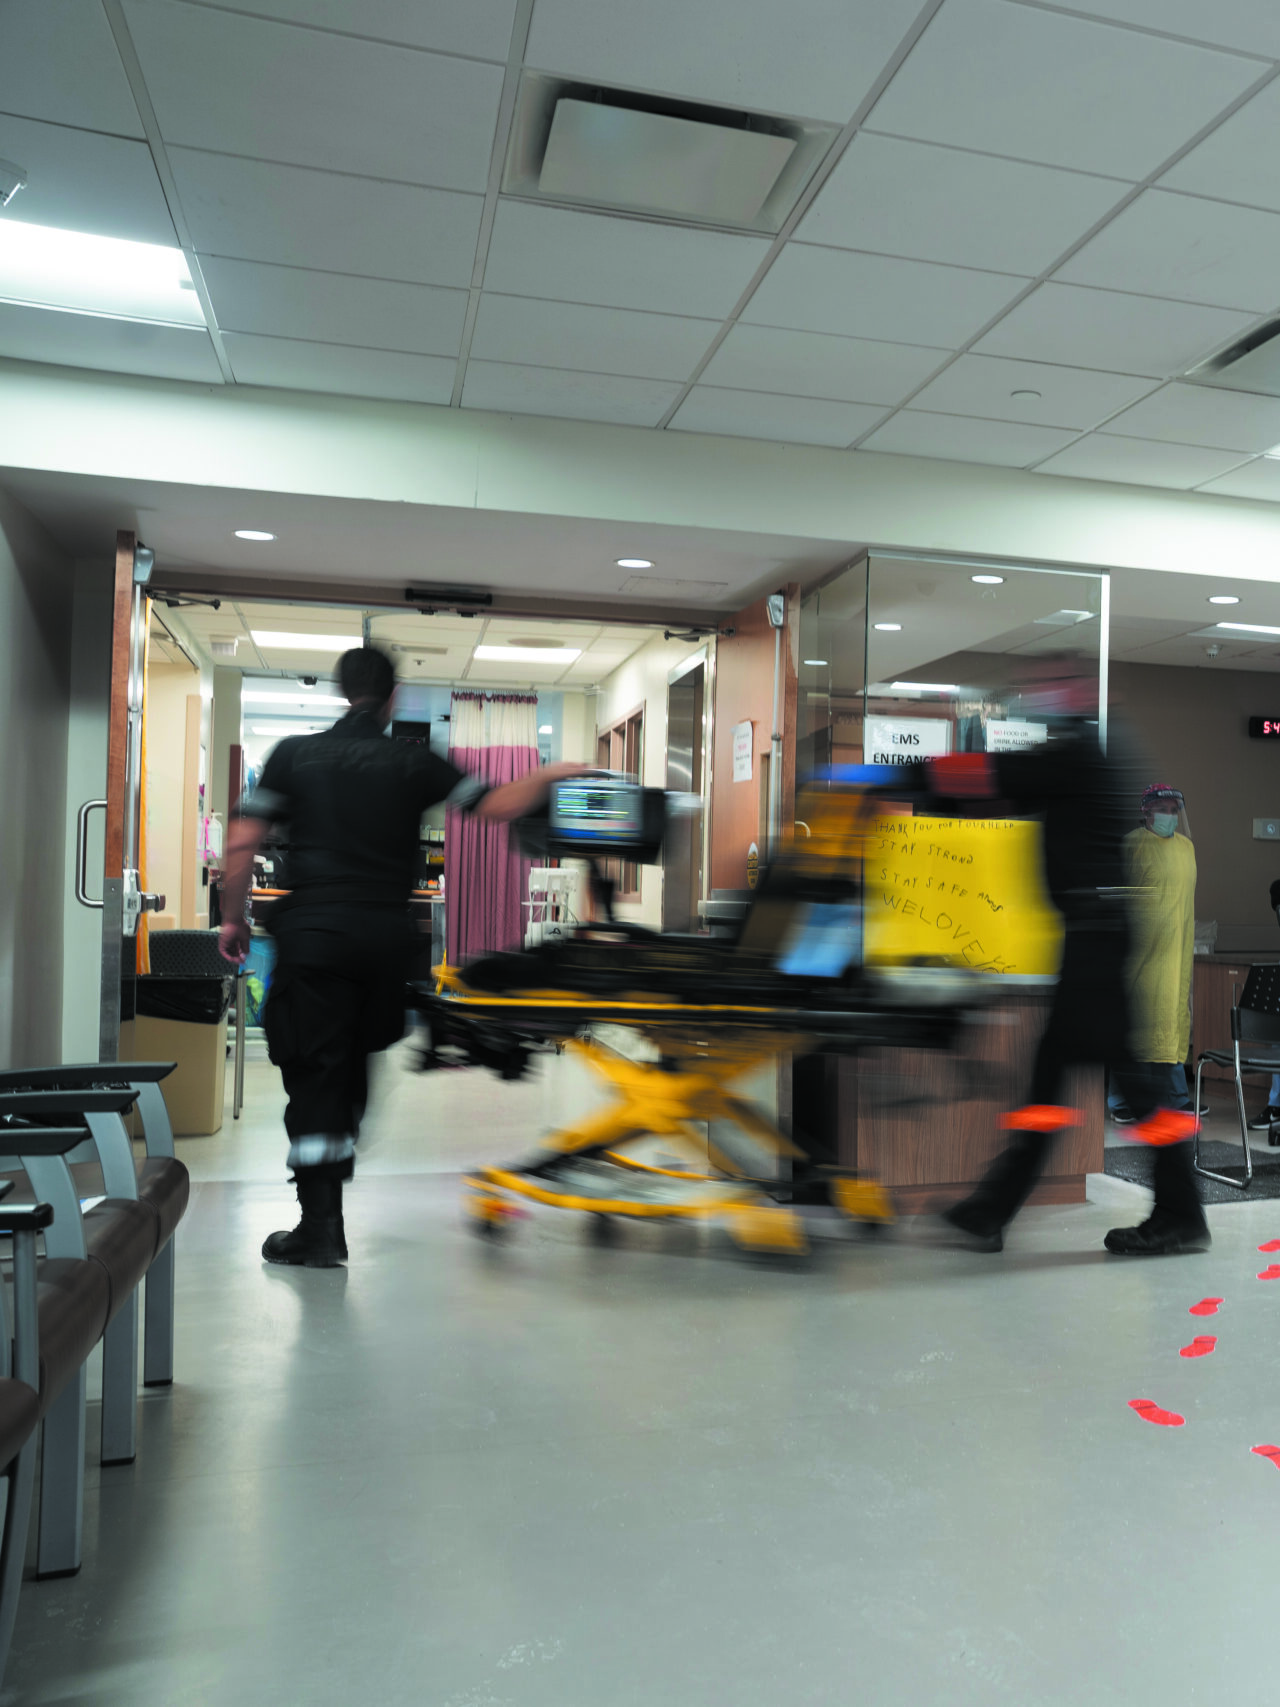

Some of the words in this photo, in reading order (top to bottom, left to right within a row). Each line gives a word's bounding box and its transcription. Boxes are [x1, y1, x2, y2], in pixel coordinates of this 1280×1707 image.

[892, 734, 919, 745] EMS
[874, 819, 908, 838] THANK
[878, 839, 917, 856] STAY
[880, 867, 918, 889] STAY
[925, 876, 968, 898] SAFE
